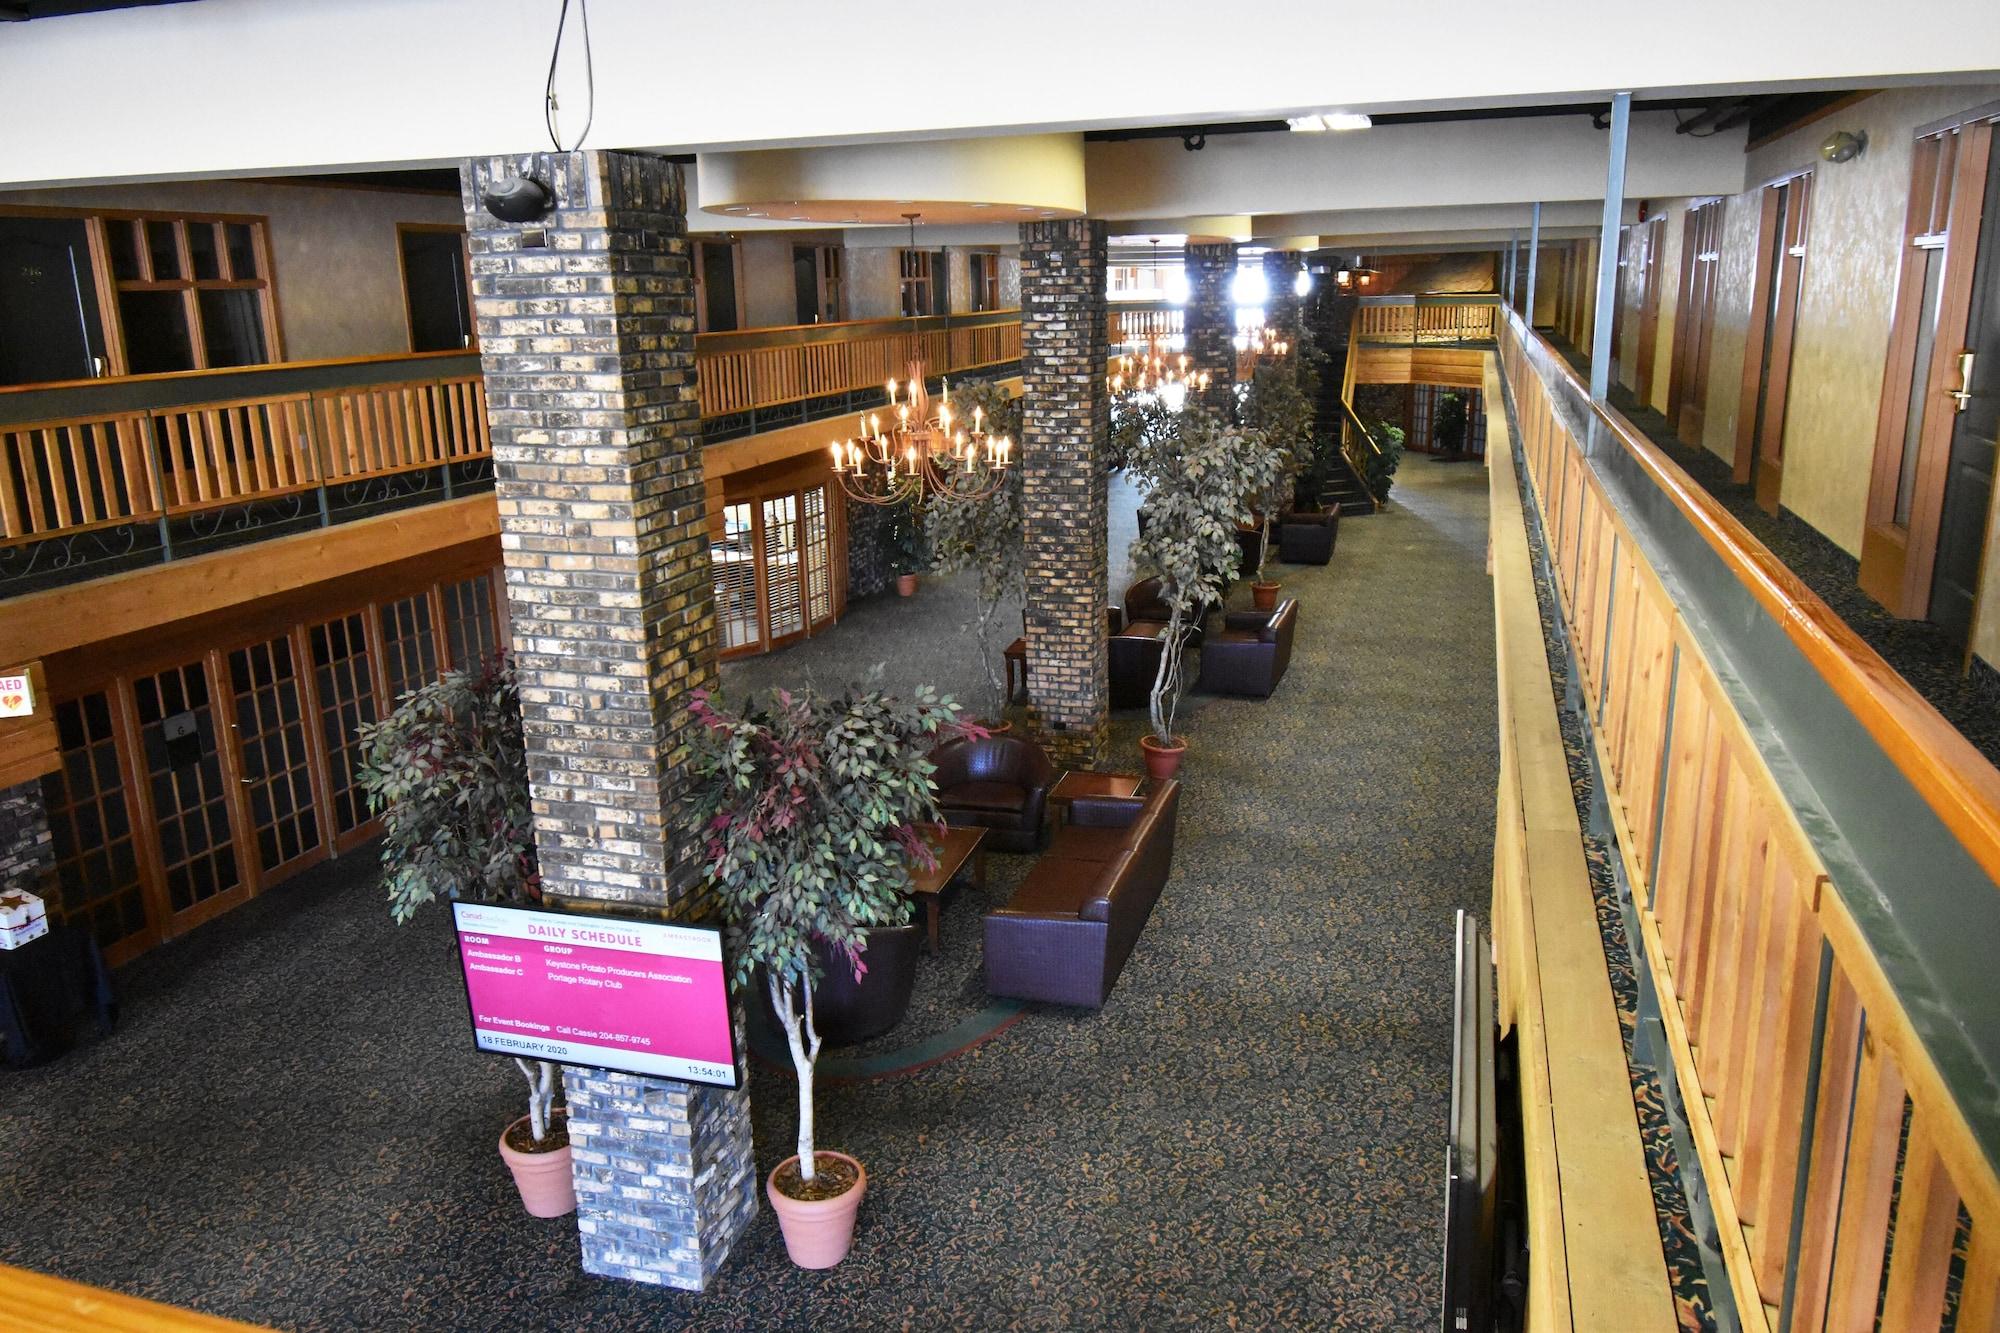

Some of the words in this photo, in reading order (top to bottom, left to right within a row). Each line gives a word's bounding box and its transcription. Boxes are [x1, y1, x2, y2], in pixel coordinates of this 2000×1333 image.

[0, 679, 22, 690] AED
[464, 935, 490, 945] ROOM
[527, 924, 566, 938] DAILY
[571, 929, 643, 947] SCHEDULE
[467, 949, 514, 962] Ambassador
[514, 955, 522, 963] B
[543, 945, 573, 955] GROUP
[469, 963, 516, 975] Ambassador
[516, 968, 524, 976] C
[545, 959, 581, 971] Keystone
[581, 963, 607, 974] Potato
[607, 966, 647, 979] Producers
[647, 971, 693, 985] Association
[547, 972, 578, 985] Portage
[578, 976, 604, 988] Rotary
[604, 980, 623, 990] Club
[479, 1014, 492, 1023] For
[492, 1016, 515, 1027] Event
[514, 1019, 551, 1032] Bookings
[556, 1025, 571, 1035] Call
[572, 1027, 598, 1039] Cassie
[482, 1035, 493, 1044] 18
[495, 1037, 544, 1052] FEBRUARY
[546, 1044, 568, 1055] 2020
[687, 1065, 727, 1079] 13:54:01
